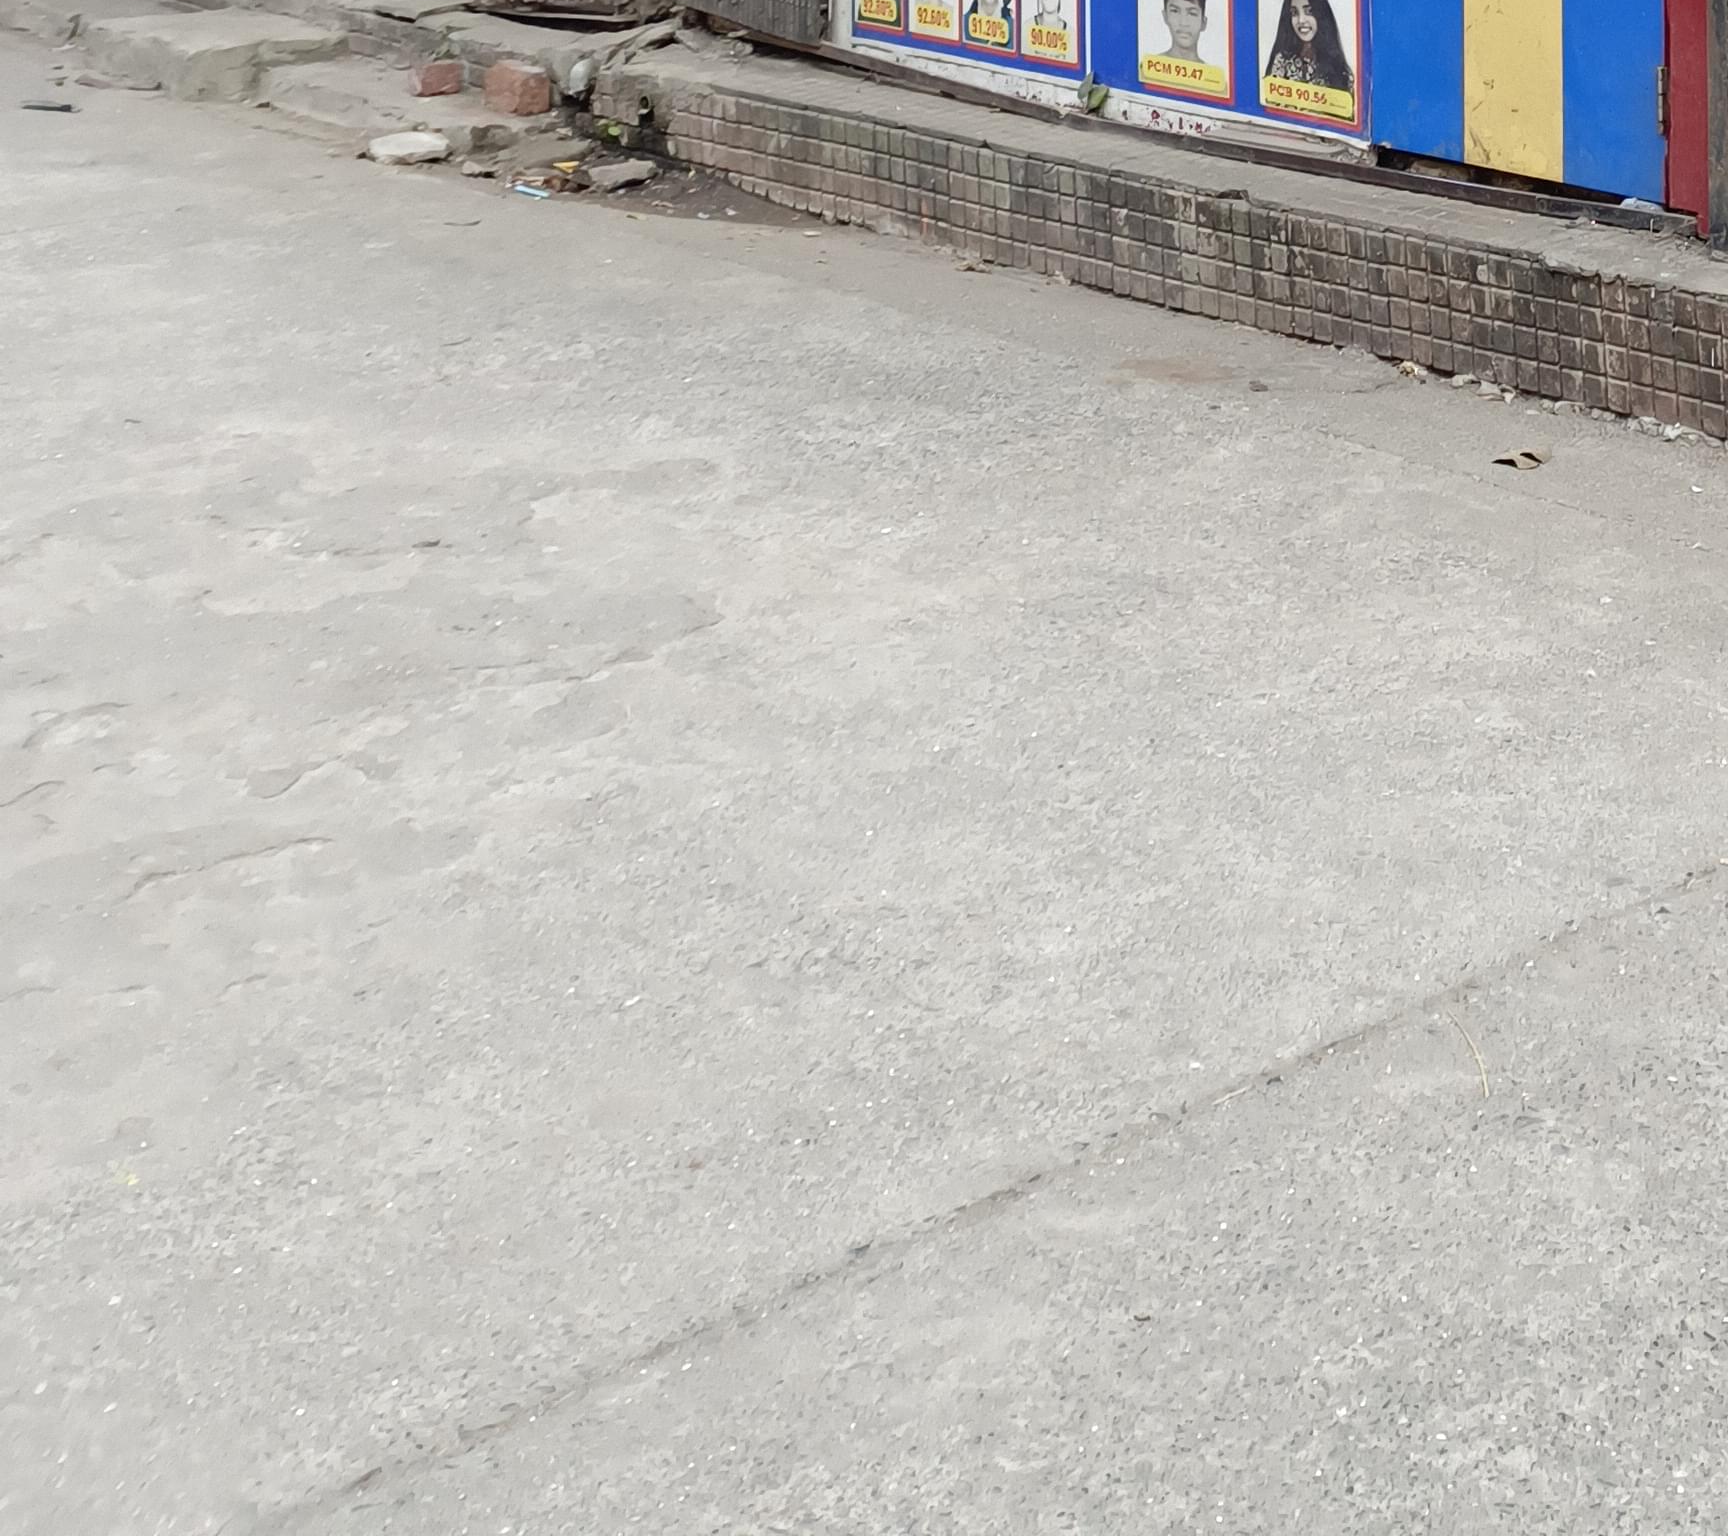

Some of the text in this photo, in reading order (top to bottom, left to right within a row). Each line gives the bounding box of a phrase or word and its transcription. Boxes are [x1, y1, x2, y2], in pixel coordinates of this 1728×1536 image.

[971, 16, 1006, 40] 91.20%
[1031, 27, 1067, 52] 90.00%
[1147, 59, 1172, 76] PCM
[1175, 65, 1203, 82] 93.47
[1269, 82, 1293, 98] PCB
